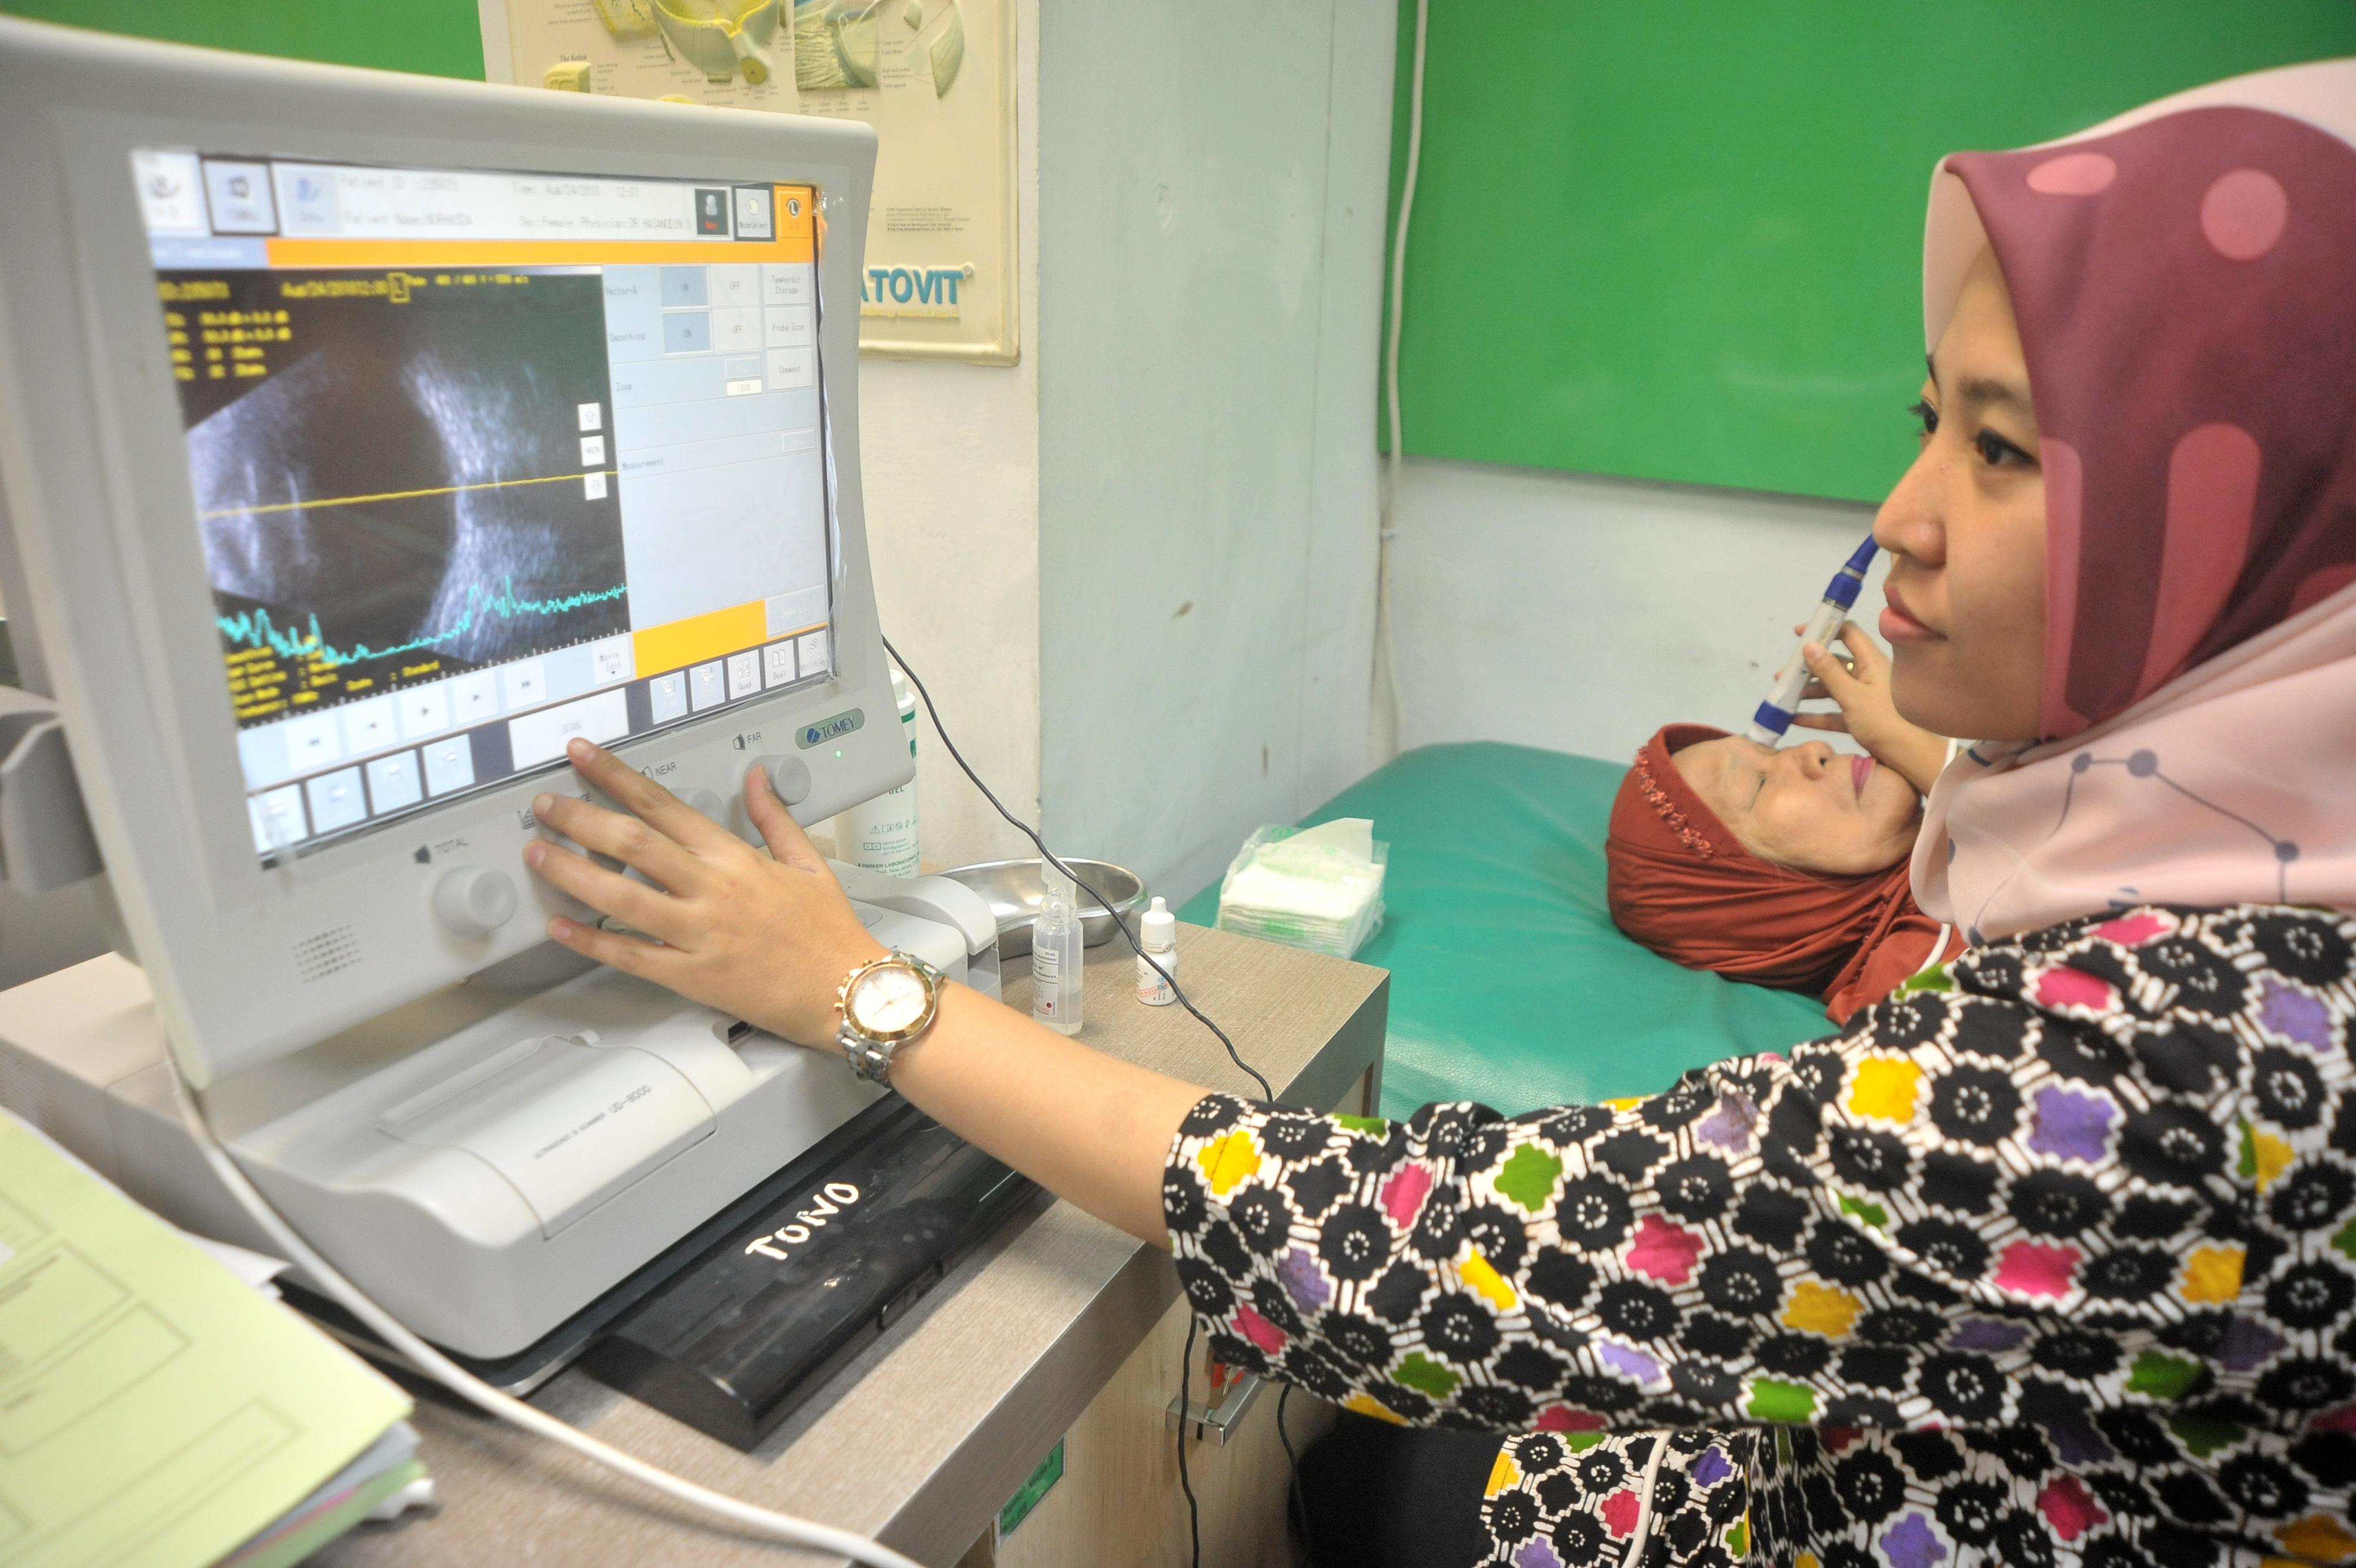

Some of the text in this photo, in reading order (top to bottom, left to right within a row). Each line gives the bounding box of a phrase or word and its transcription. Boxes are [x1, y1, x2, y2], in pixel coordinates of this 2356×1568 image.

[730, 281, 740, 290] OFF
[732, 325, 742, 335] OFF
[772, 322, 805, 332] Probe Icon
[773, 670, 786, 680] Dual
[738, 681, 752, 691] Quad
[819, 716, 855, 740] TOMEY
[747, 732, 762, 744] FAR
[655, 762, 677, 777] NEAR
[435, 837, 469, 854] TOTAL
